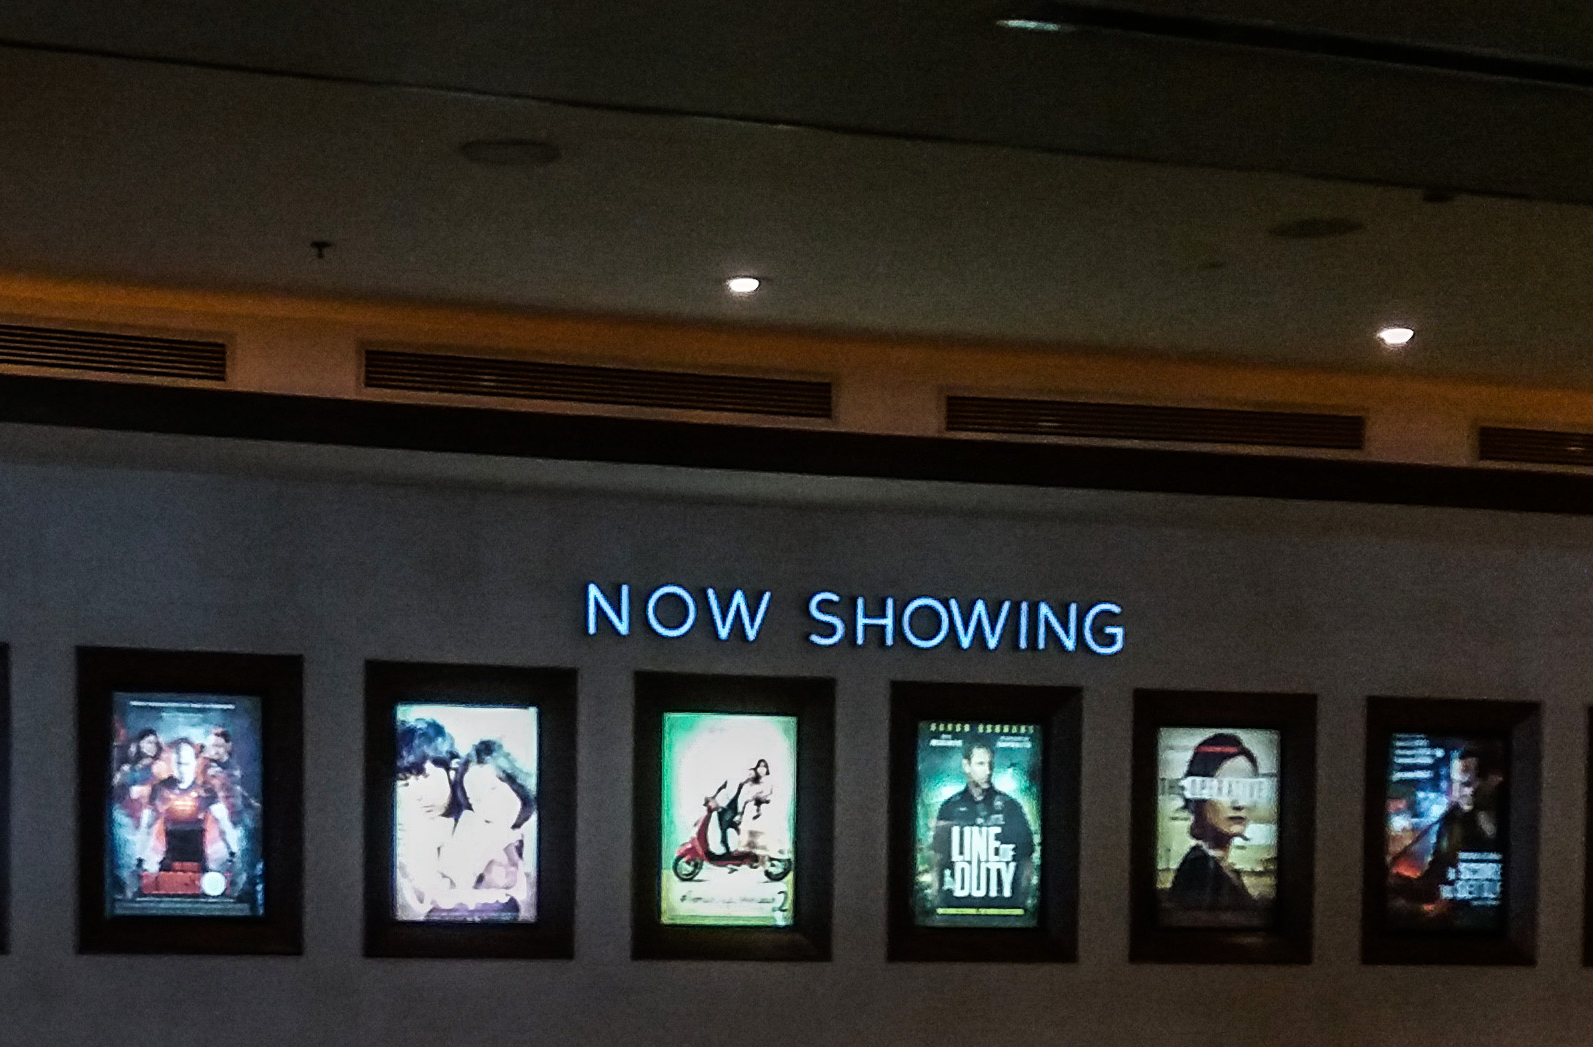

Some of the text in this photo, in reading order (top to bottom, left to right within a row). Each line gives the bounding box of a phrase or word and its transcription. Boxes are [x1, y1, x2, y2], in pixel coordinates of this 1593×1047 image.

[585, 582, 1126, 656] NOW SHOWING
[951, 826, 1017, 861] LINE OF
[953, 862, 1017, 898] DUTY
